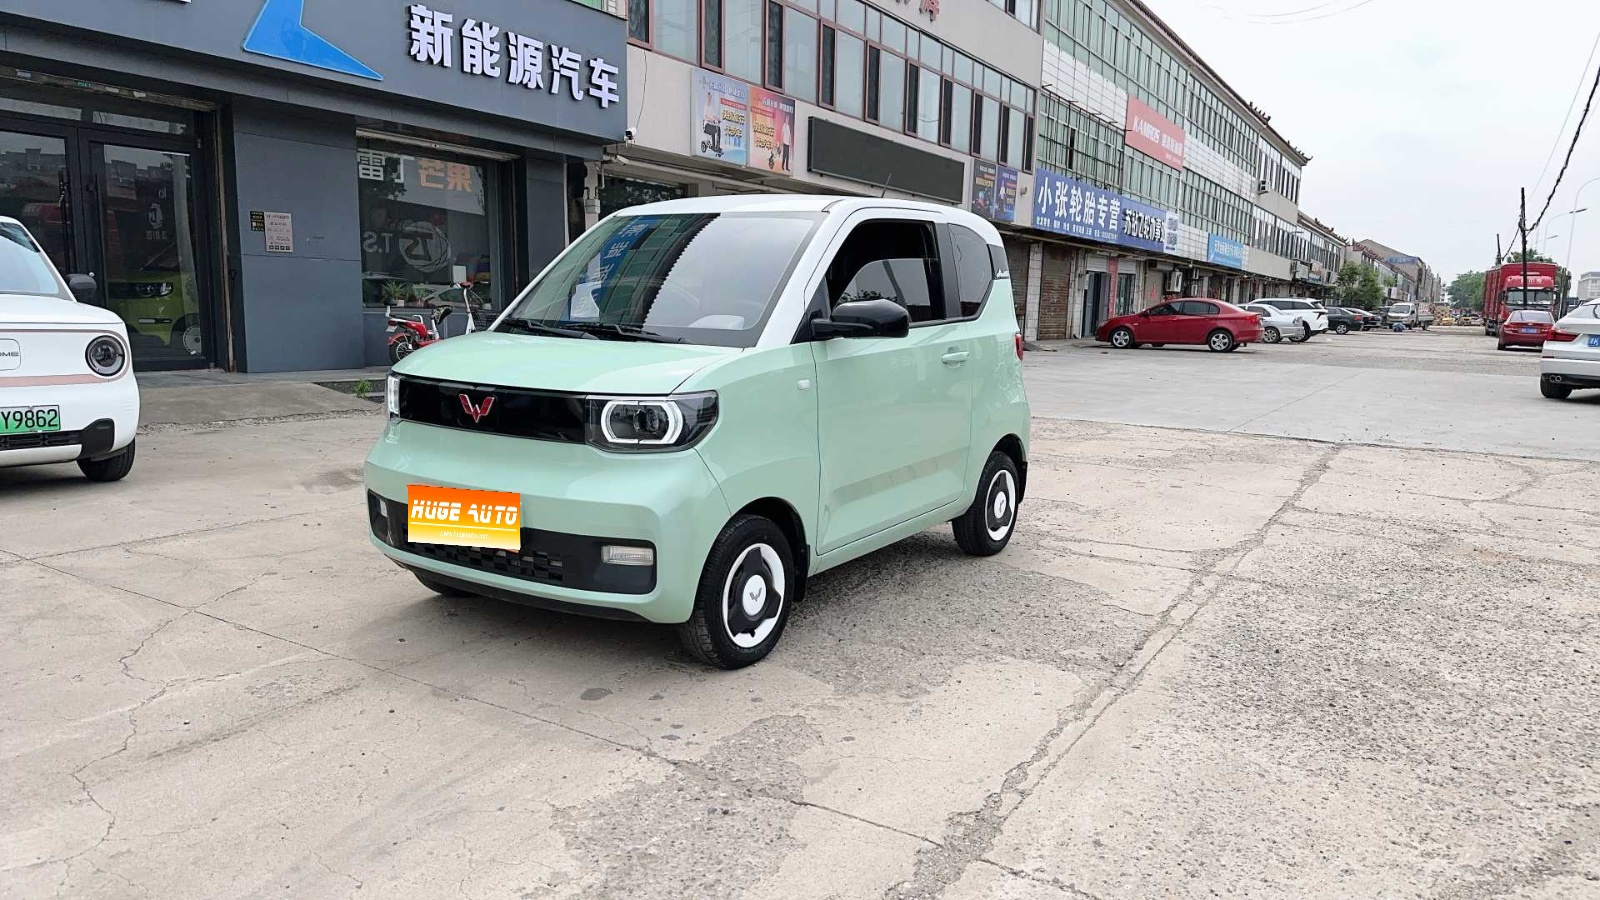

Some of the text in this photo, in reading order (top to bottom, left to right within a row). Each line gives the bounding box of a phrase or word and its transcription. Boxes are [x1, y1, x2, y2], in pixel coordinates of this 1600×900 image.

[409, 4, 620, 109] 新能源汽车
[1037, 177, 1121, 231] 小张轮胎专营
[0, 408, 59, 430] Y9862
